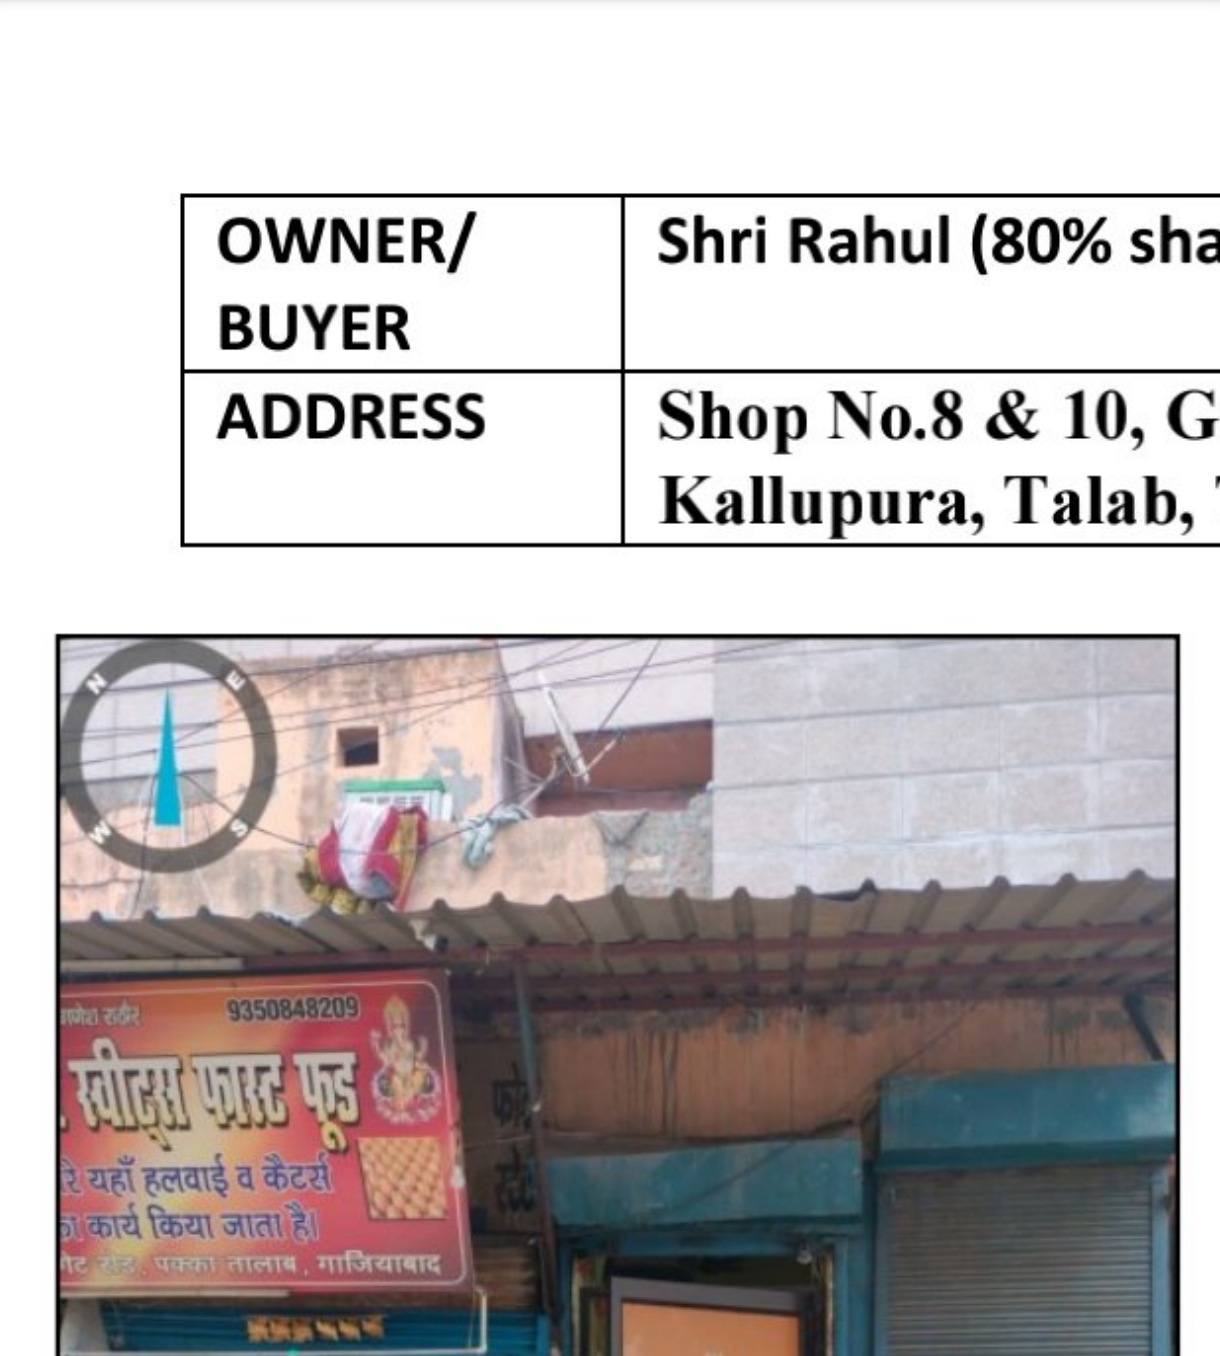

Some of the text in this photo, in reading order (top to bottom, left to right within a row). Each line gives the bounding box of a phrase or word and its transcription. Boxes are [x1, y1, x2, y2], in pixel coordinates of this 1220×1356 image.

[218, 211, 476, 273] OWNER/
[659, 212, 1220, 276] Shri Rahul (80% sha
[219, 303, 411, 351] BUYER
[217, 392, 486, 440] ADDRESS
[660, 389, 808, 455] Shop
[829, 389, 963, 441] No.8
[986, 389, 1039, 441] &
[1067, 389, 1145, 451] 10,
[660, 475, 1194, 540] Kallupura, Talab,
[228, 996, 359, 1022] 9350848209
[192, 1053, 288, 1128] फास्ट
[293, 1052, 360, 1152] फूड
[87, 1155, 136, 1198] यहाँ
[142, 1153, 229, 1198] हलवाई
[236, 1166, 254, 1190] व
[262, 1152, 332, 1191] कैटर्स
[88, 1202, 142, 1240] कार्य
[146, 1203, 214, 1239] किया
[221, 1213, 283, 1239] जाता
